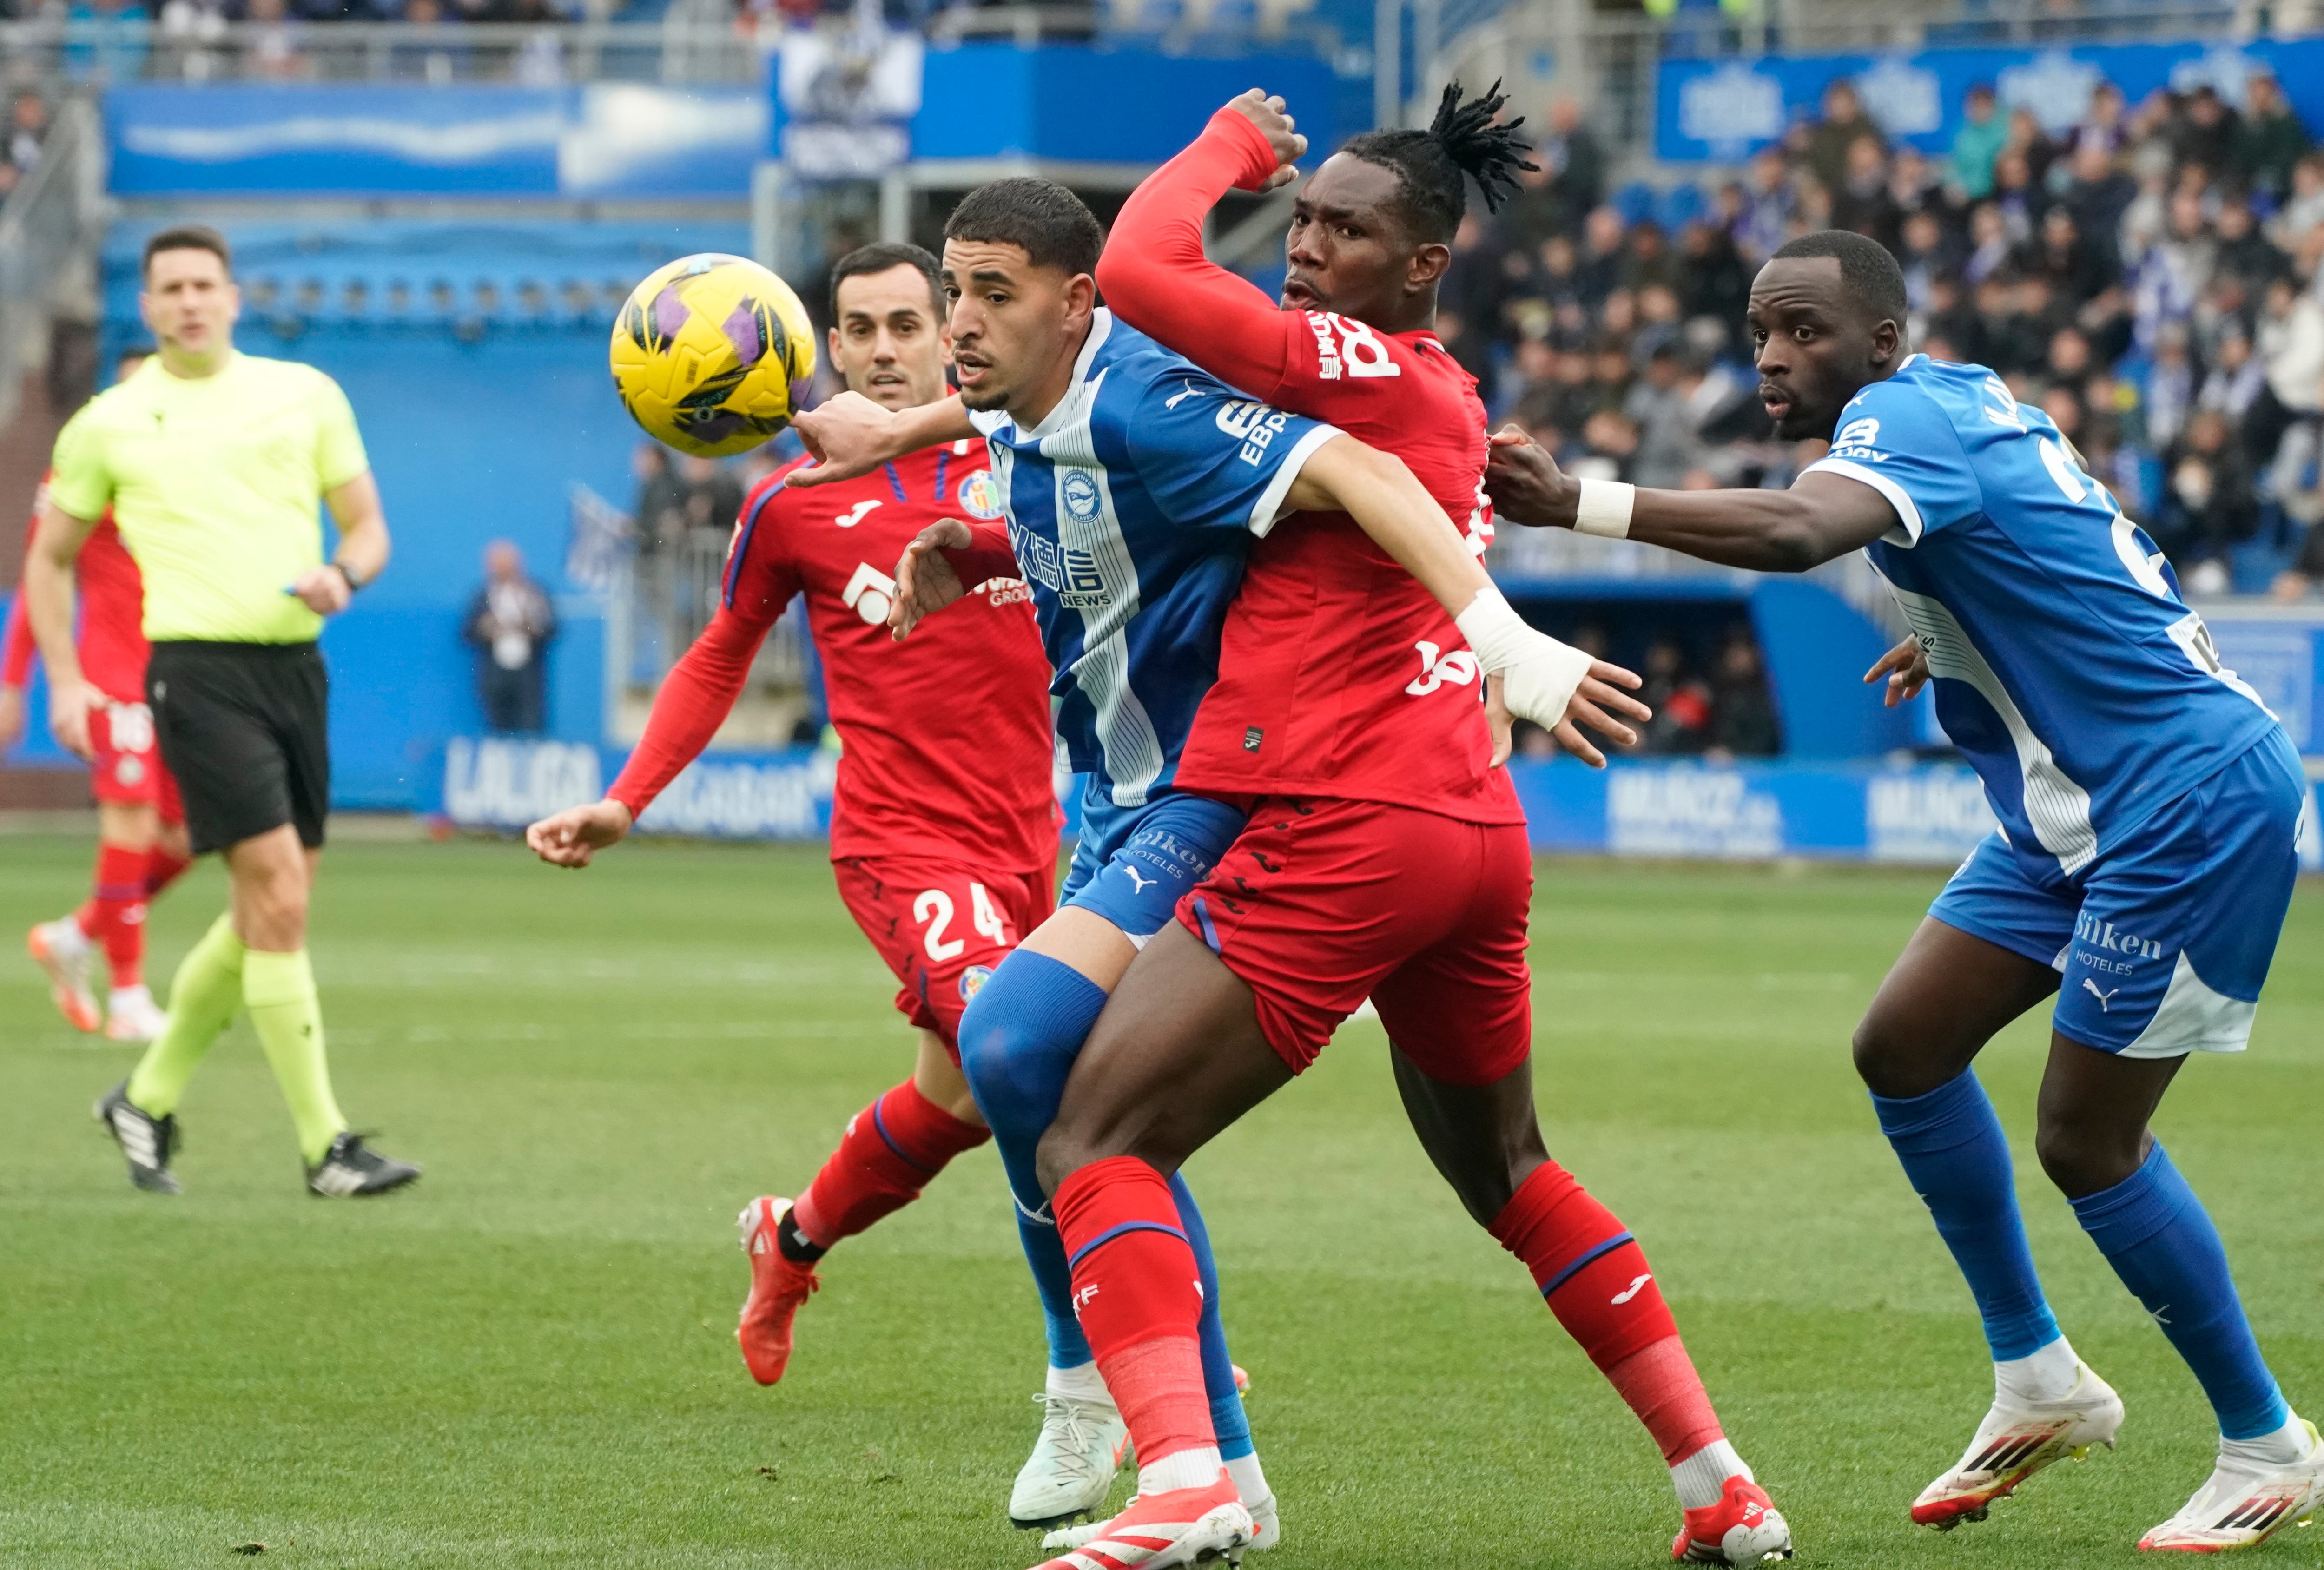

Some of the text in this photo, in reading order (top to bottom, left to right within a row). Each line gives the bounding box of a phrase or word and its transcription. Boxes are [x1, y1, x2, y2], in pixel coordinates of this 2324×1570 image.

[1061, 593, 1112, 607] NEWS
[913, 882, 1007, 962] 24
[2075, 909, 2161, 960] Silken
[2076, 949, 2133, 976] HOTELES
